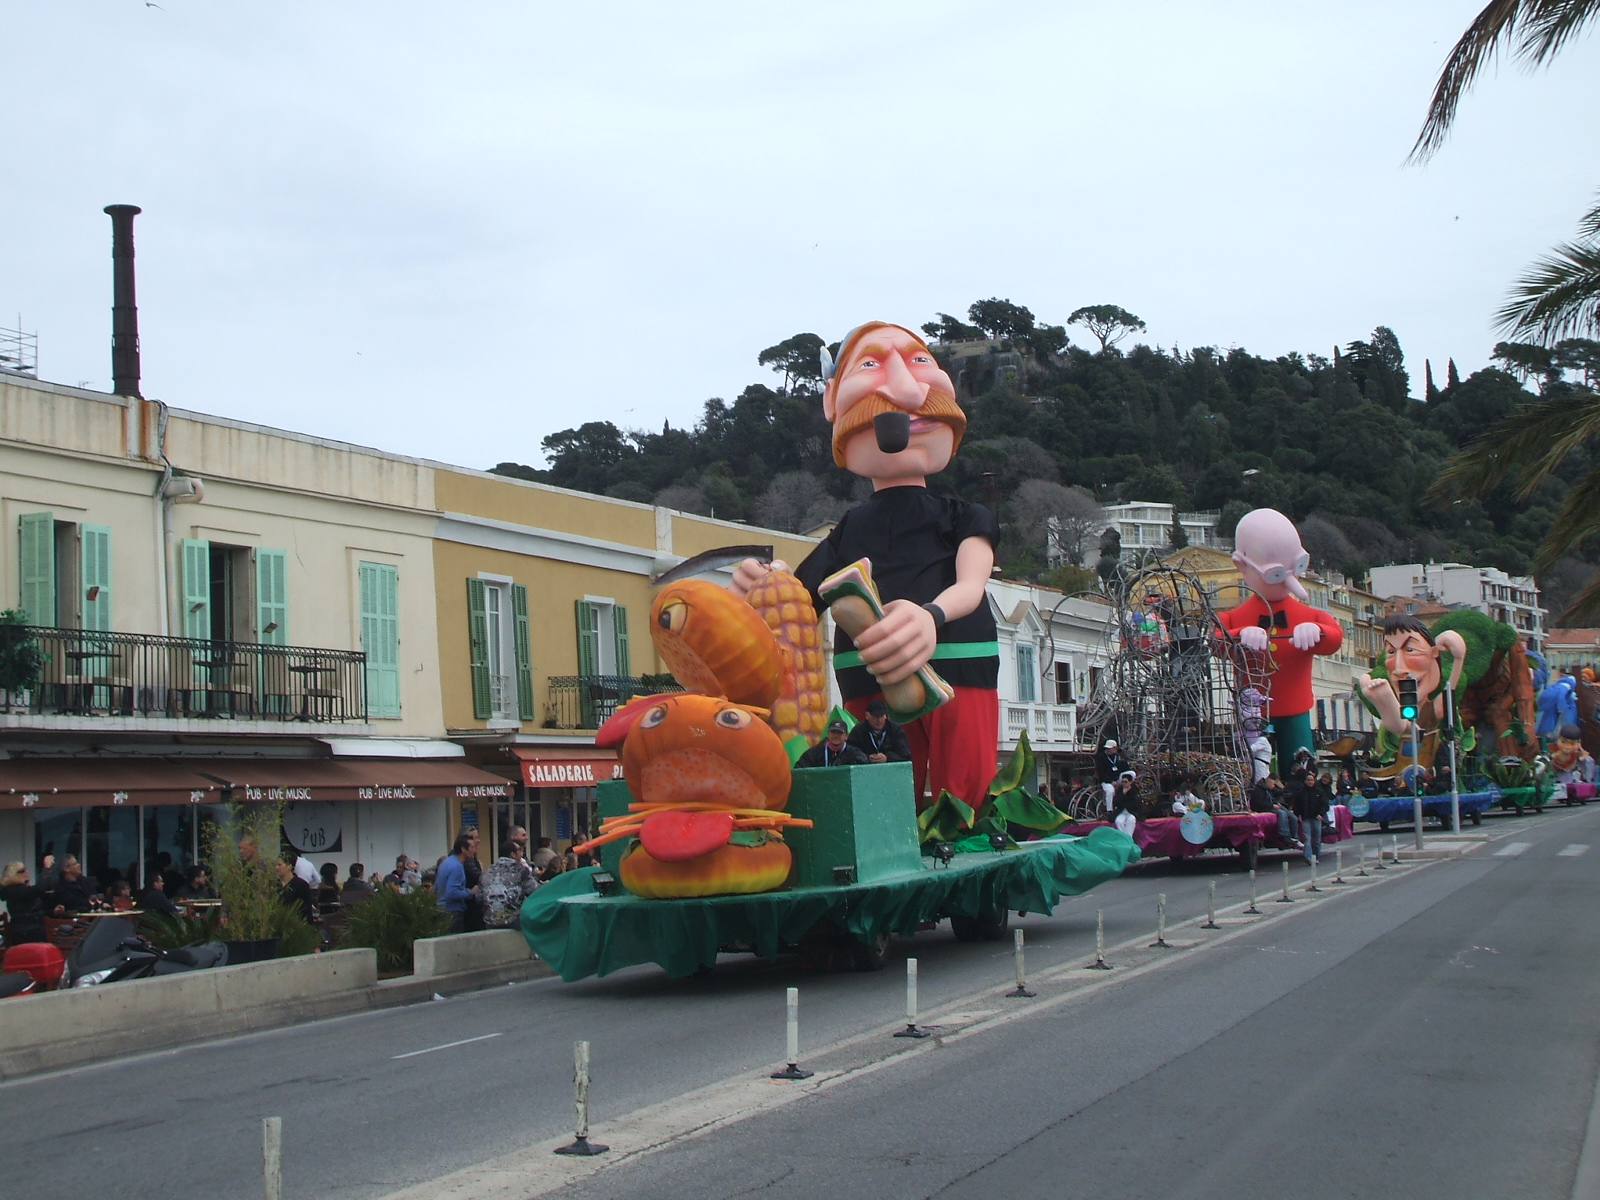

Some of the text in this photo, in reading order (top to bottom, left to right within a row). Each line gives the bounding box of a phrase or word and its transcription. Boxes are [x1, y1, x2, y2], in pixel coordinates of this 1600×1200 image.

[528, 764, 594, 783] SALADERIE
[246, 787, 262, 800] PUB
[268, 787, 285, 800] LIVE
[285, 787, 312, 800] MUSIC
[358, 787, 373, 799] PUB
[378, 786, 393, 799] LIVE
[393, 786, 416, 799] MUSIC
[456, 785, 469, 797] PUB
[473, 785, 486, 797] LIVE
[486, 785, 506, 796] MUSIC
[302, 827, 326, 848] PUB
